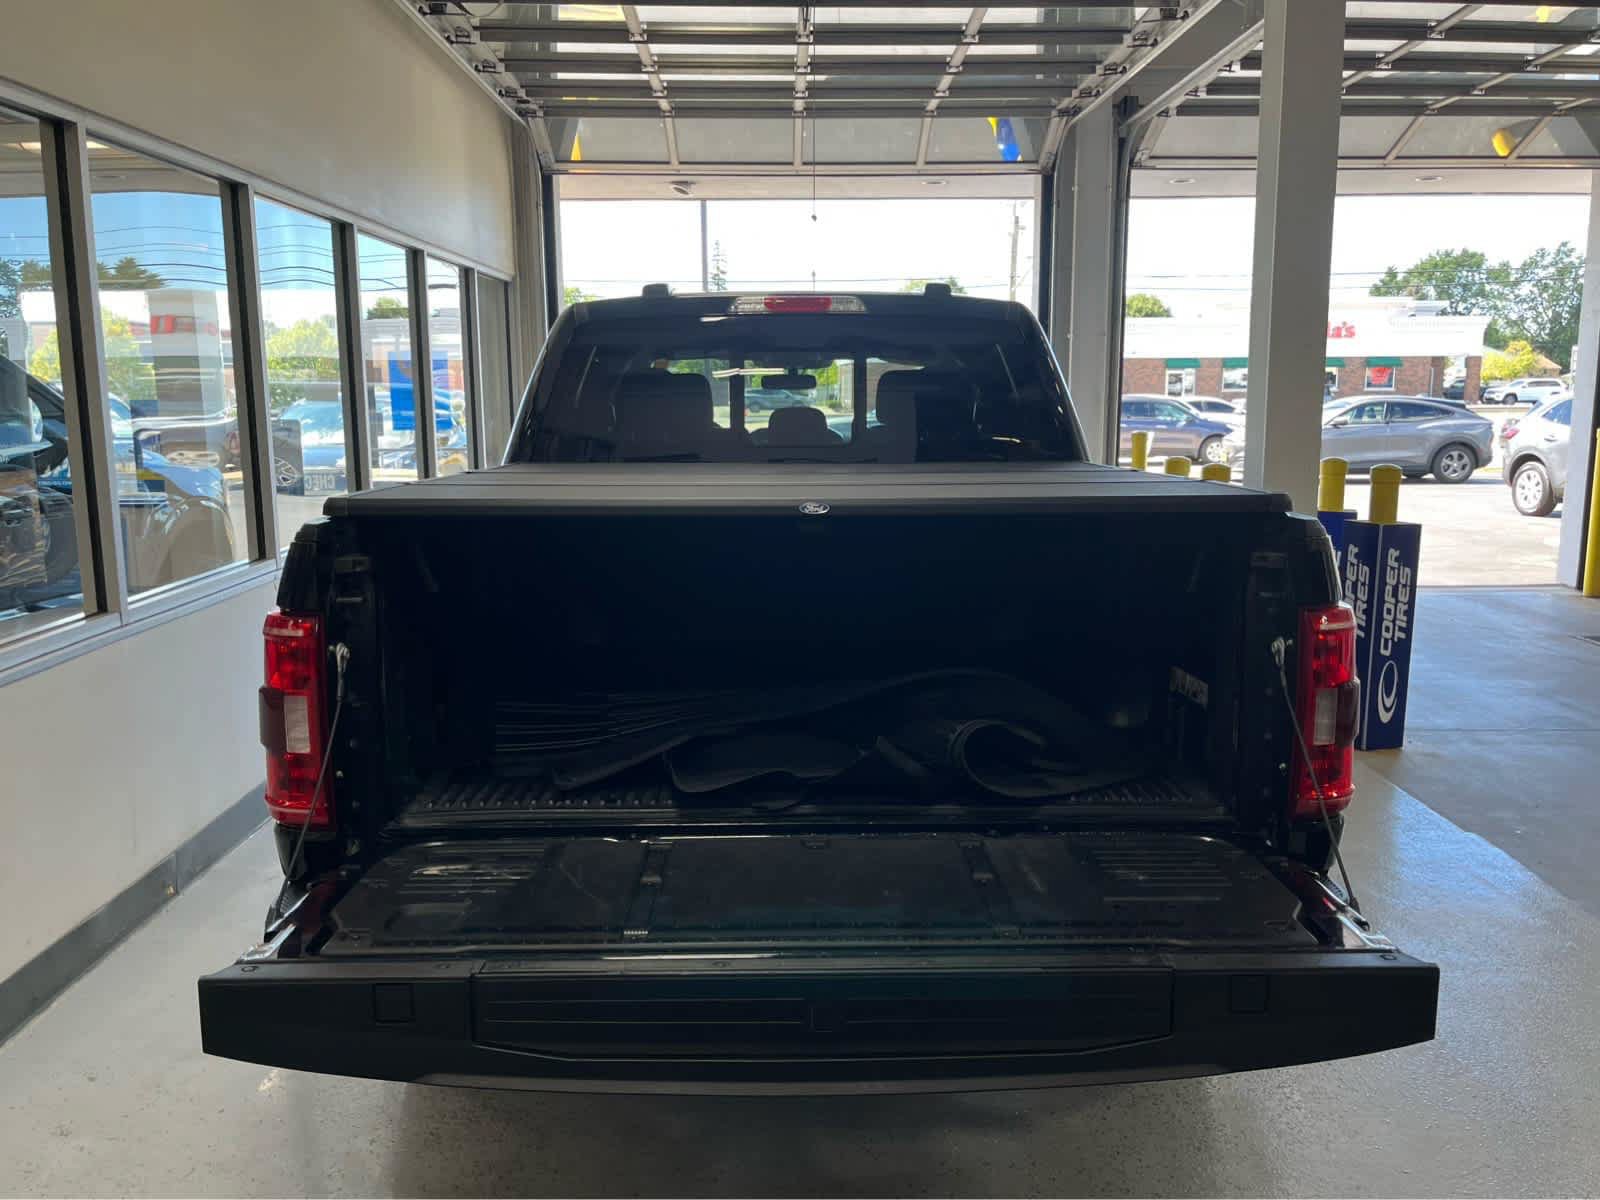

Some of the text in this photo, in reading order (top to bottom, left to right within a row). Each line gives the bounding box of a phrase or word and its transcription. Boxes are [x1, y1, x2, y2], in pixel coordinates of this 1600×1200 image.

[1354, 563, 1370, 639] TIRES
[1379, 548, 1400, 657] COOPER
[1393, 565, 1411, 643] TIRES
